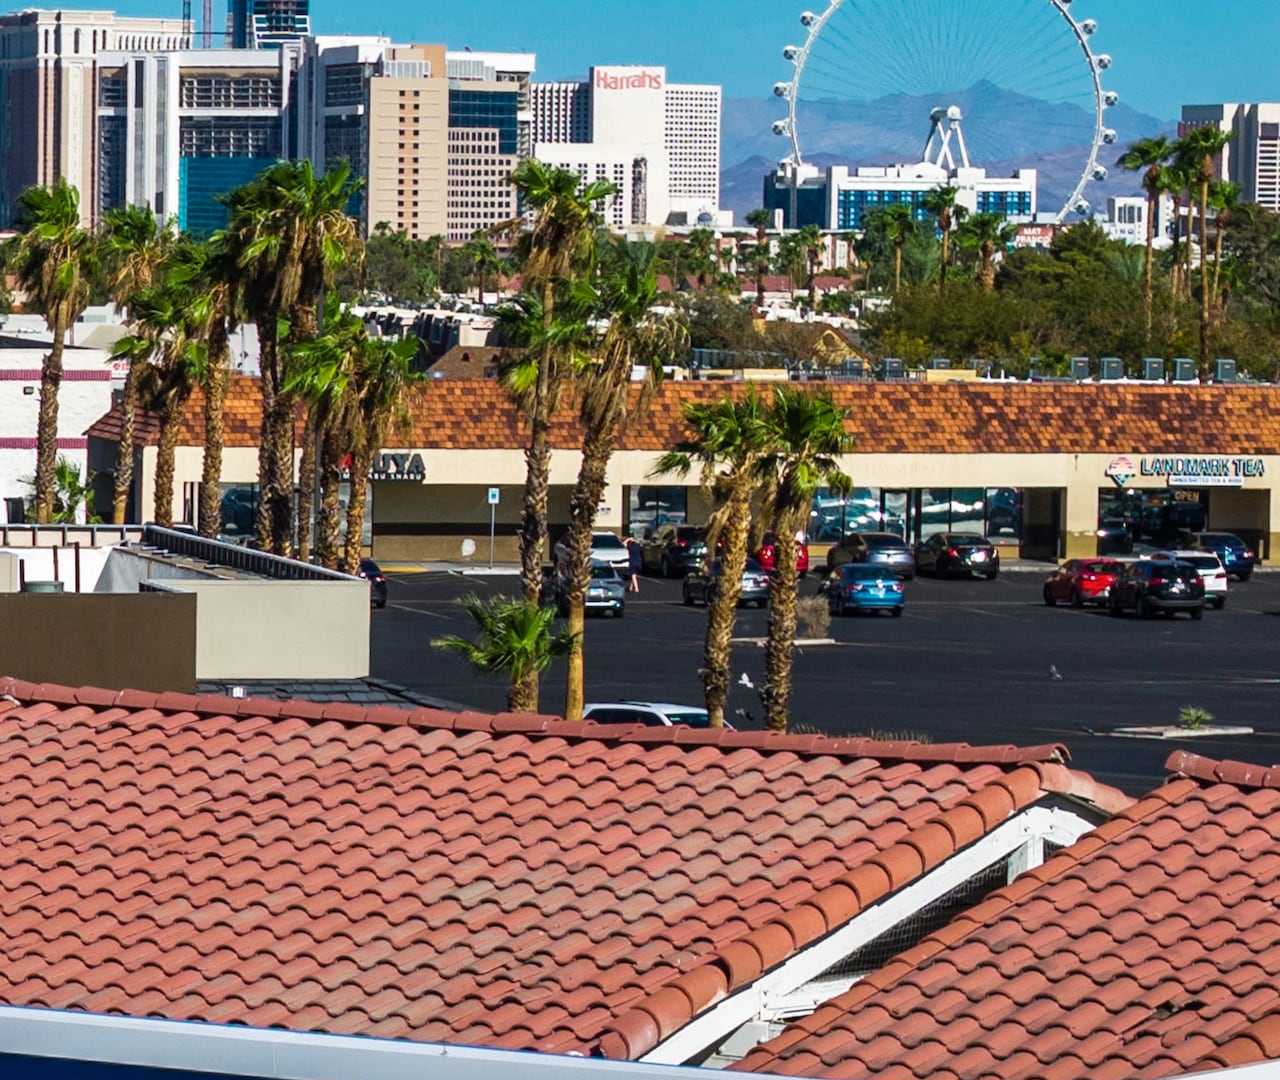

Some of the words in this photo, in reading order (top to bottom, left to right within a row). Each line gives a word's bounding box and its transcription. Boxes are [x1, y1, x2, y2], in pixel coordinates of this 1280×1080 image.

[1141, 458, 1229, 475] LANDMARK
[1232, 458, 1266, 475] TEA
[1175, 491, 1200, 502] OPEN
